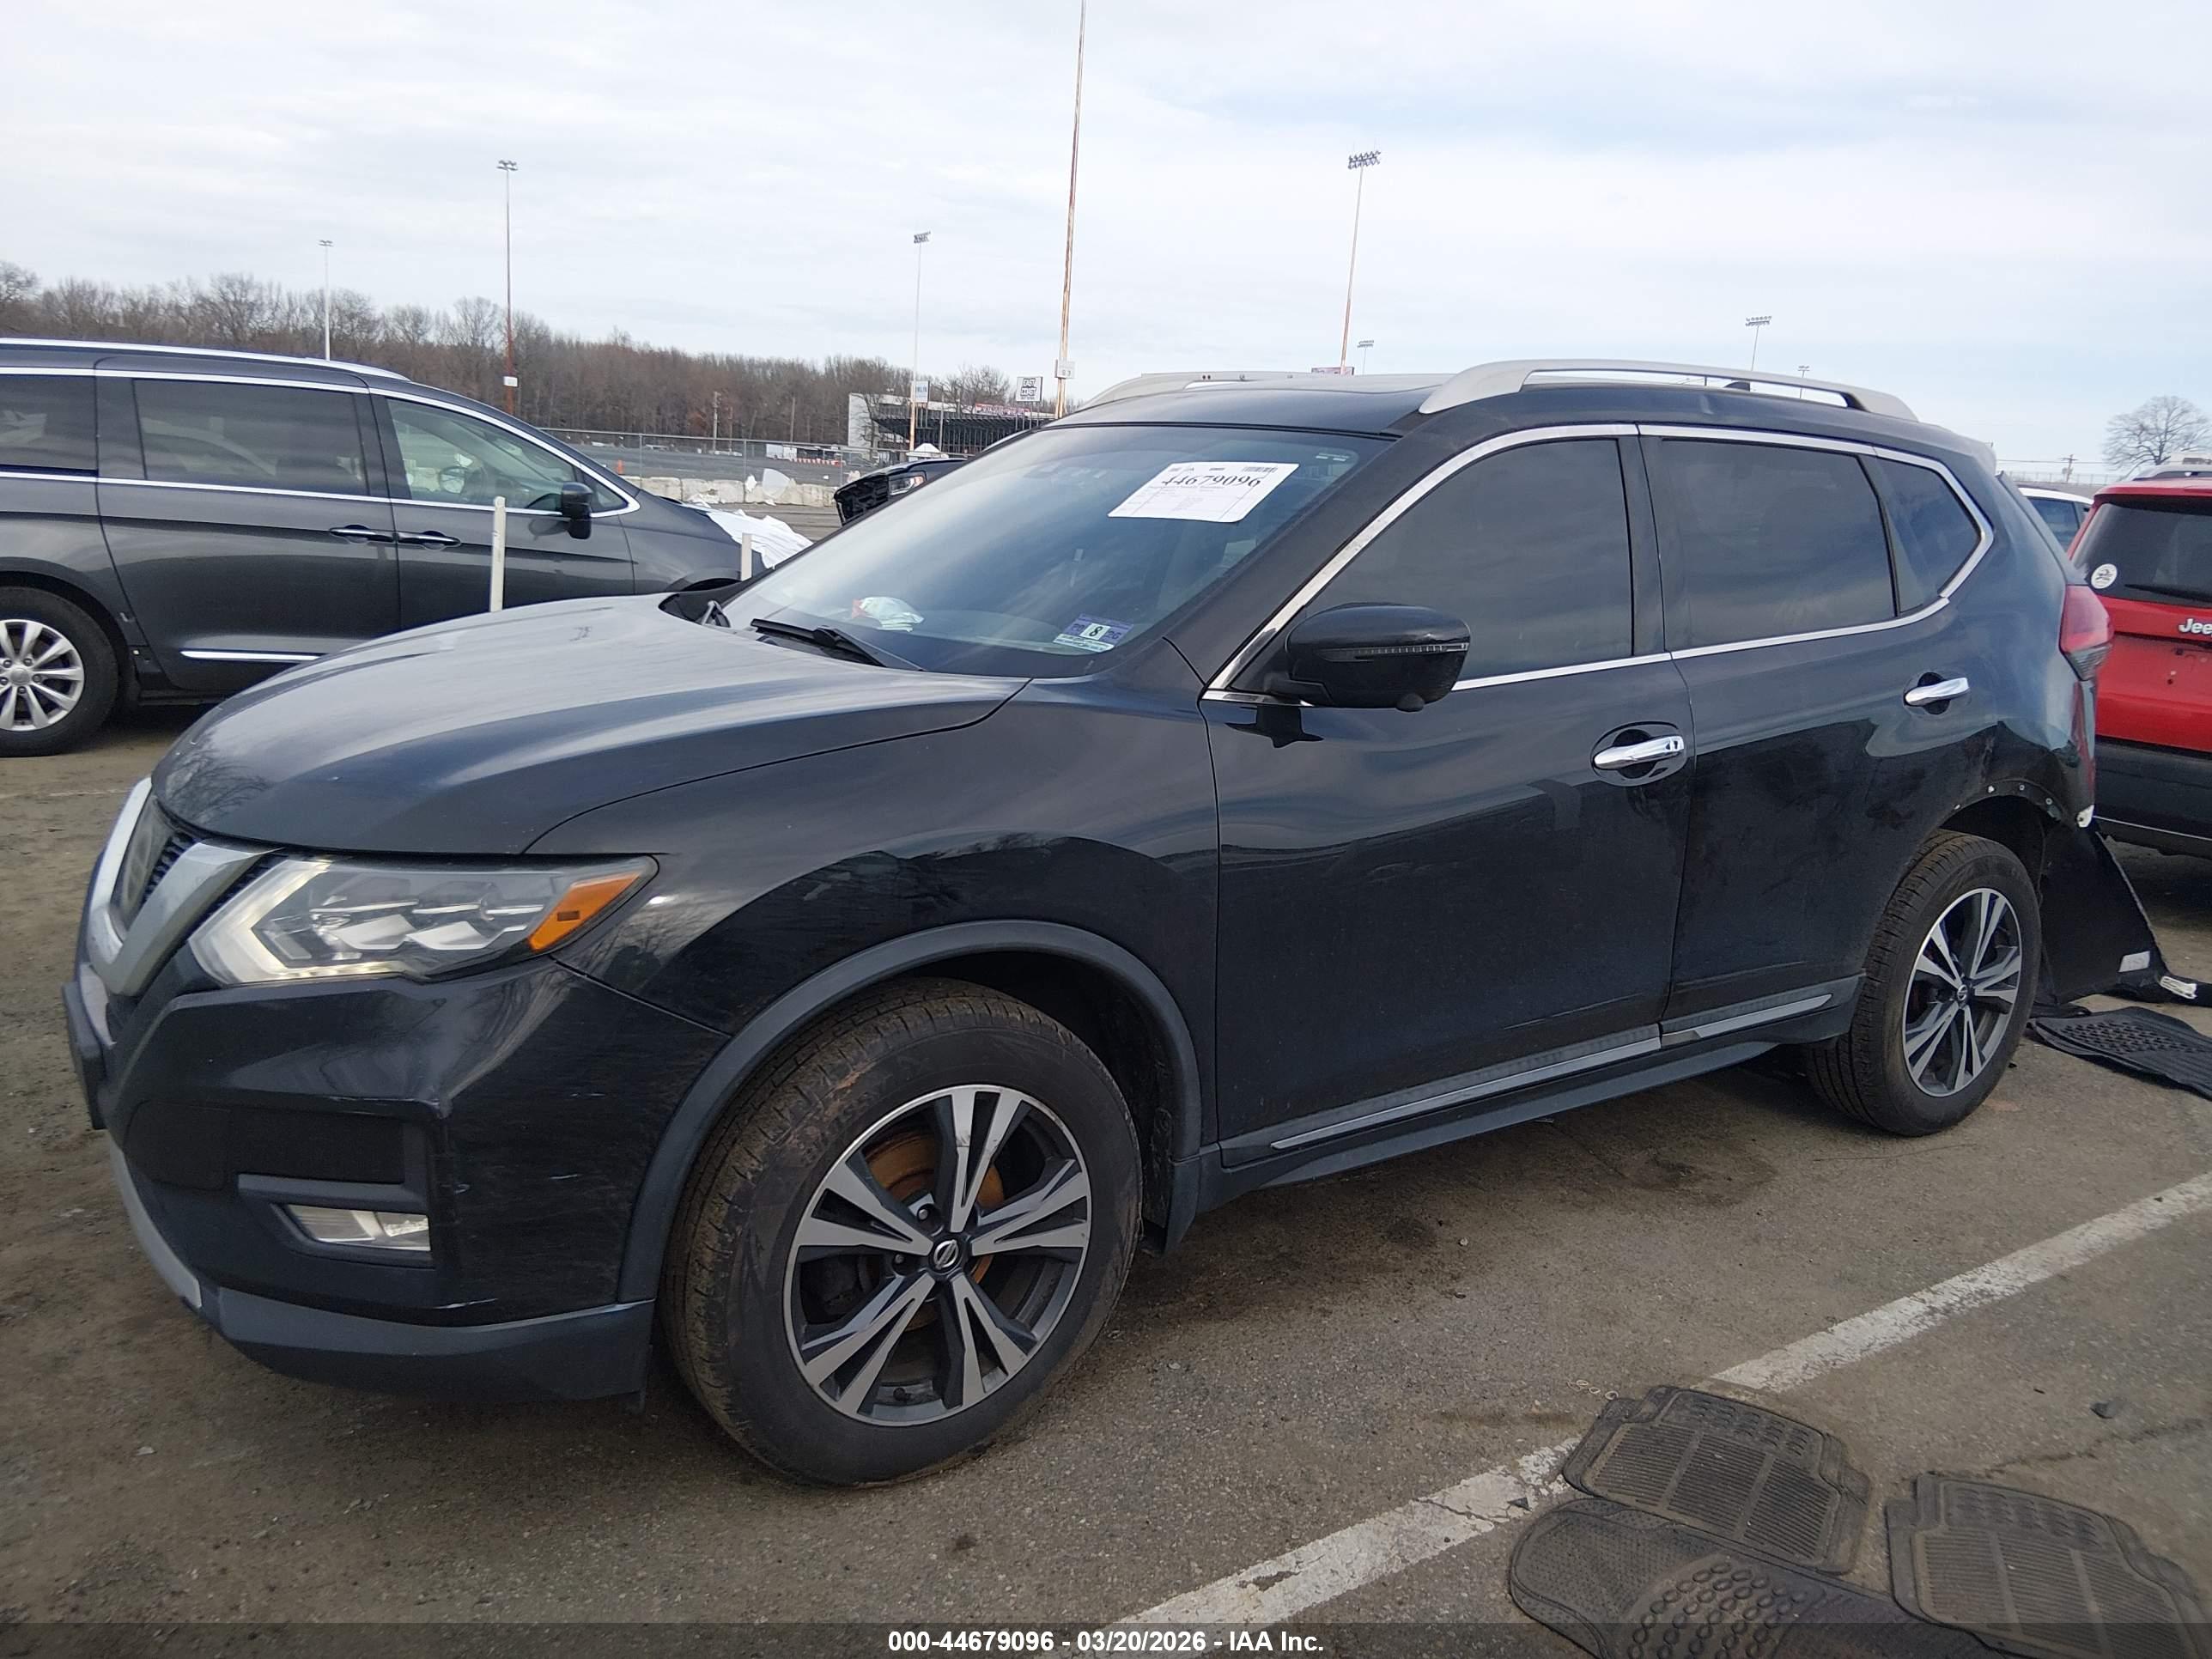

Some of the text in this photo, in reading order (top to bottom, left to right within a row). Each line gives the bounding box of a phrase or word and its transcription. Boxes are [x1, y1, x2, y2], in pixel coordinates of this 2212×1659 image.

[1161, 475, 1261, 488] 44679096
[1090, 626, 1103, 636] 8
[2179, 618, 2212, 637] Jee
